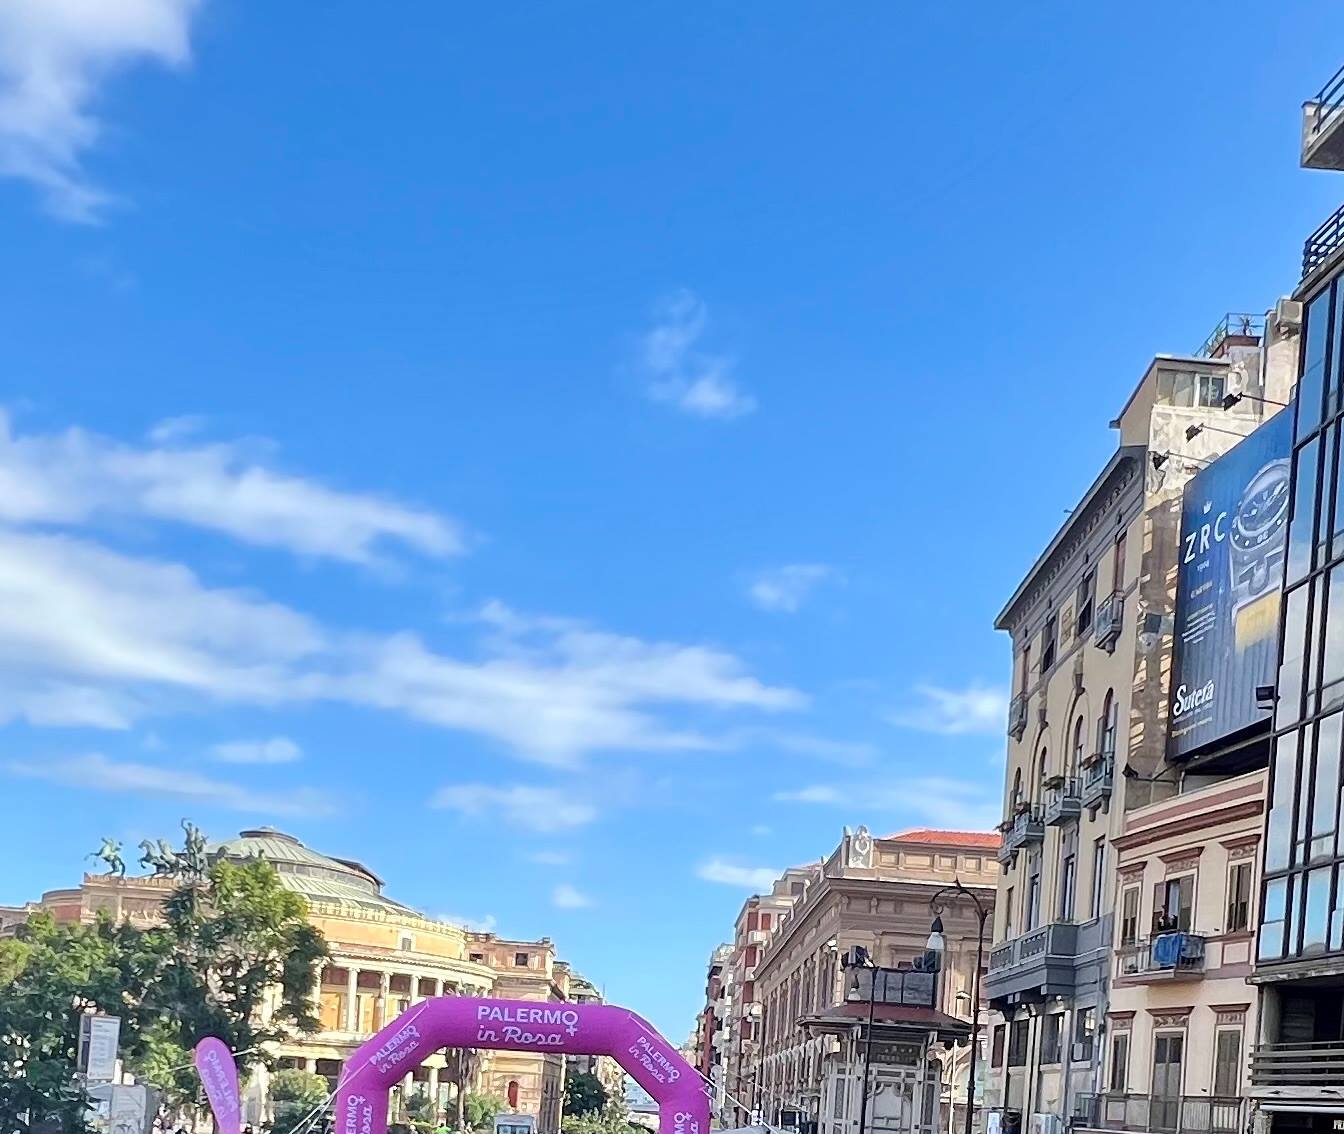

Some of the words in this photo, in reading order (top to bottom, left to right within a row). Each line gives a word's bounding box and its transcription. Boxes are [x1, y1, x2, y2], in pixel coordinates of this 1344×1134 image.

[1183, 511, 1227, 564] ZRC
[477, 1005, 579, 1036] PALERMO
[477, 1025, 499, 1042] in
[502, 1026, 564, 1045] Rosa
[370, 1025, 419, 1065] PALERMO
[388, 1041, 419, 1065] Rosa
[637, 1036, 680, 1081] PALERMO
[640, 1054, 665, 1083] Rosa
